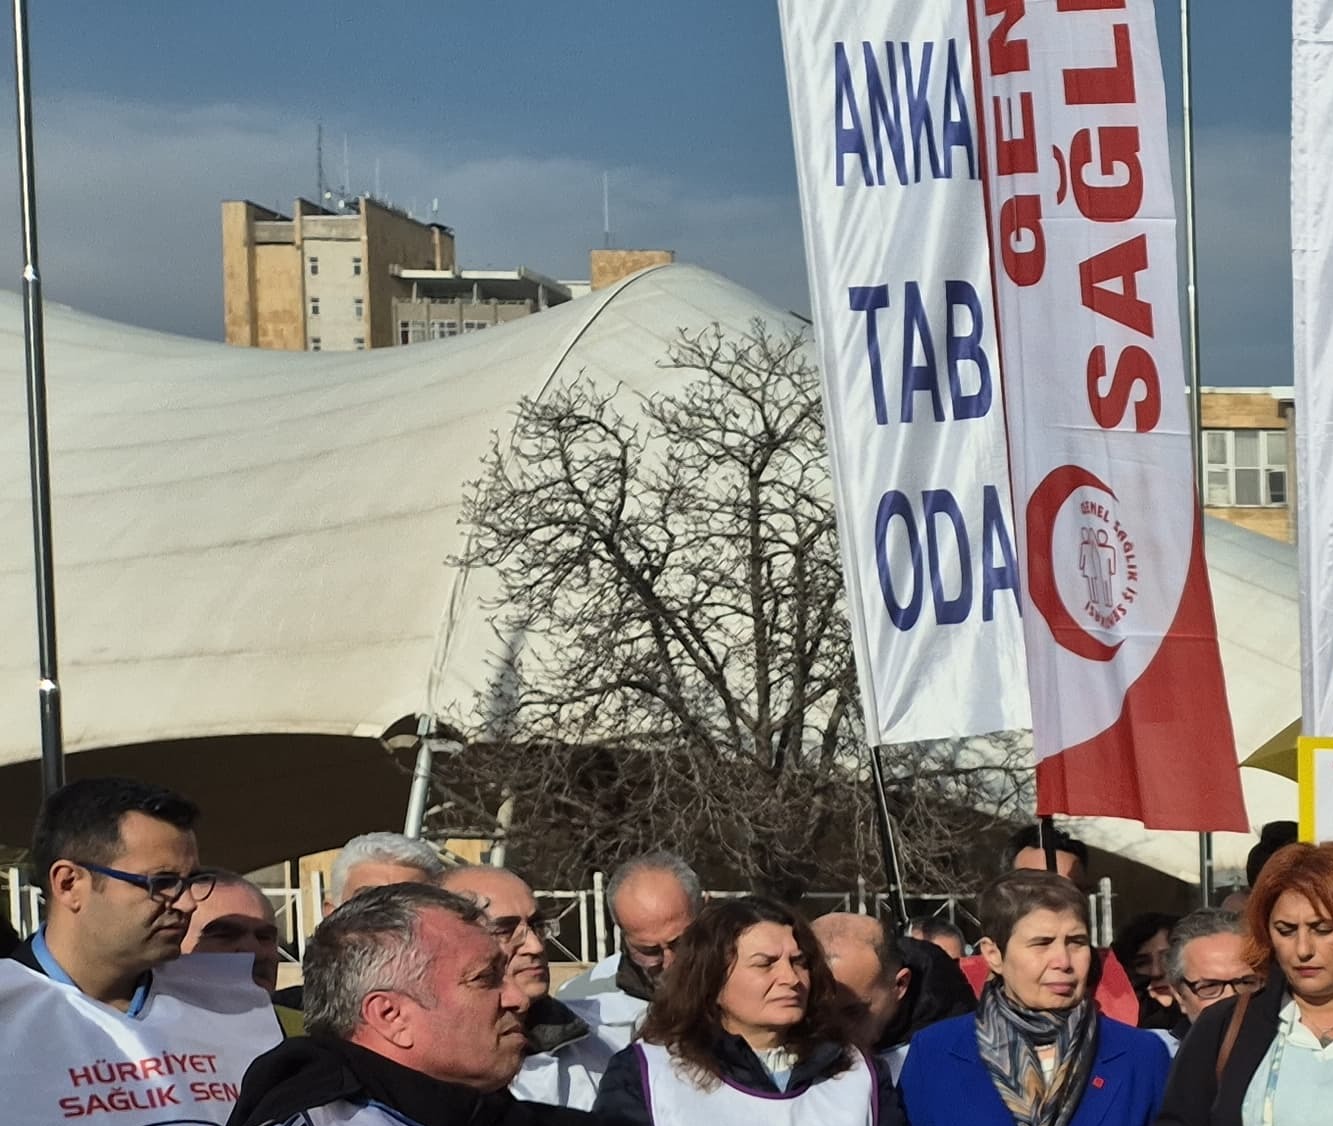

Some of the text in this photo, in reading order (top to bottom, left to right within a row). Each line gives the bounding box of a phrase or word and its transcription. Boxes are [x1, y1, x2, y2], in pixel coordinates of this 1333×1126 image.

[848, 279, 993, 426] TAB
[875, 484, 1022, 632] ODA
[59, 1085, 180, 1119] SAĞLIK
[68, 1049, 218, 1088] HÜRRİYET
